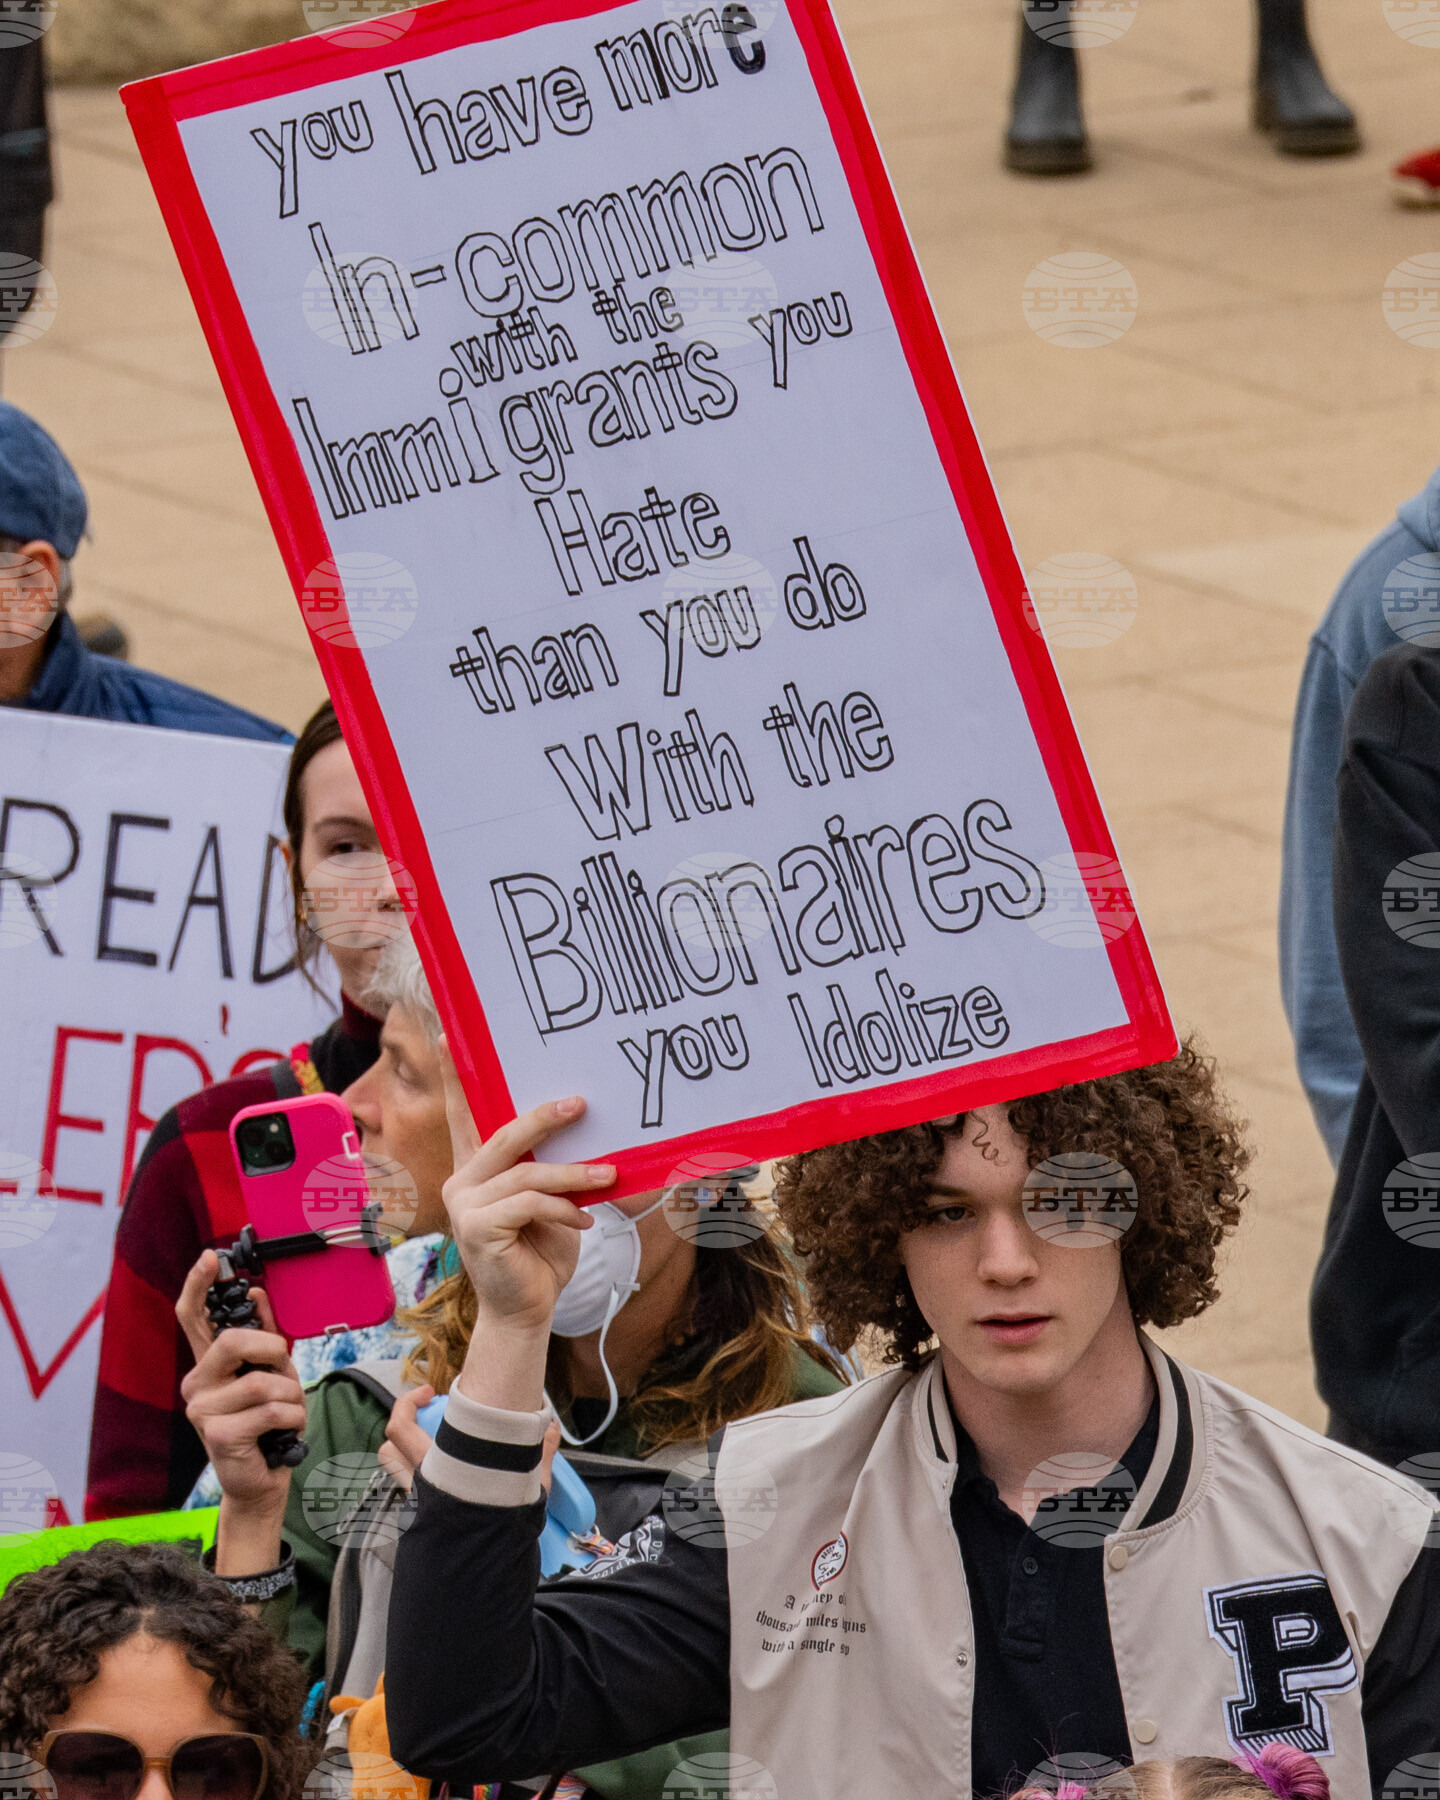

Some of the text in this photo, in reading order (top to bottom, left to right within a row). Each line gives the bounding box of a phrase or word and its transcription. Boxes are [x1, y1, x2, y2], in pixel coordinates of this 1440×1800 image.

[251, 3, 766, 218] you have more
[309, 145, 825, 355] In-common
[450, 282, 684, 388] with the
[291, 291, 855, 521] Immigrants you
[450, 536, 866, 717] than you do
[534, 486, 733, 597] Hate
[545, 682, 895, 841] With the
[490, 798, 1046, 1046] Billionaires
[618, 968, 1010, 1128] you Idolize
[787, 1641, 795, 1650] a
[800, 1638, 836, 1653] single
[806, 1613, 839, 1629] miles
[1204, 1570, 1360, 1758] P
